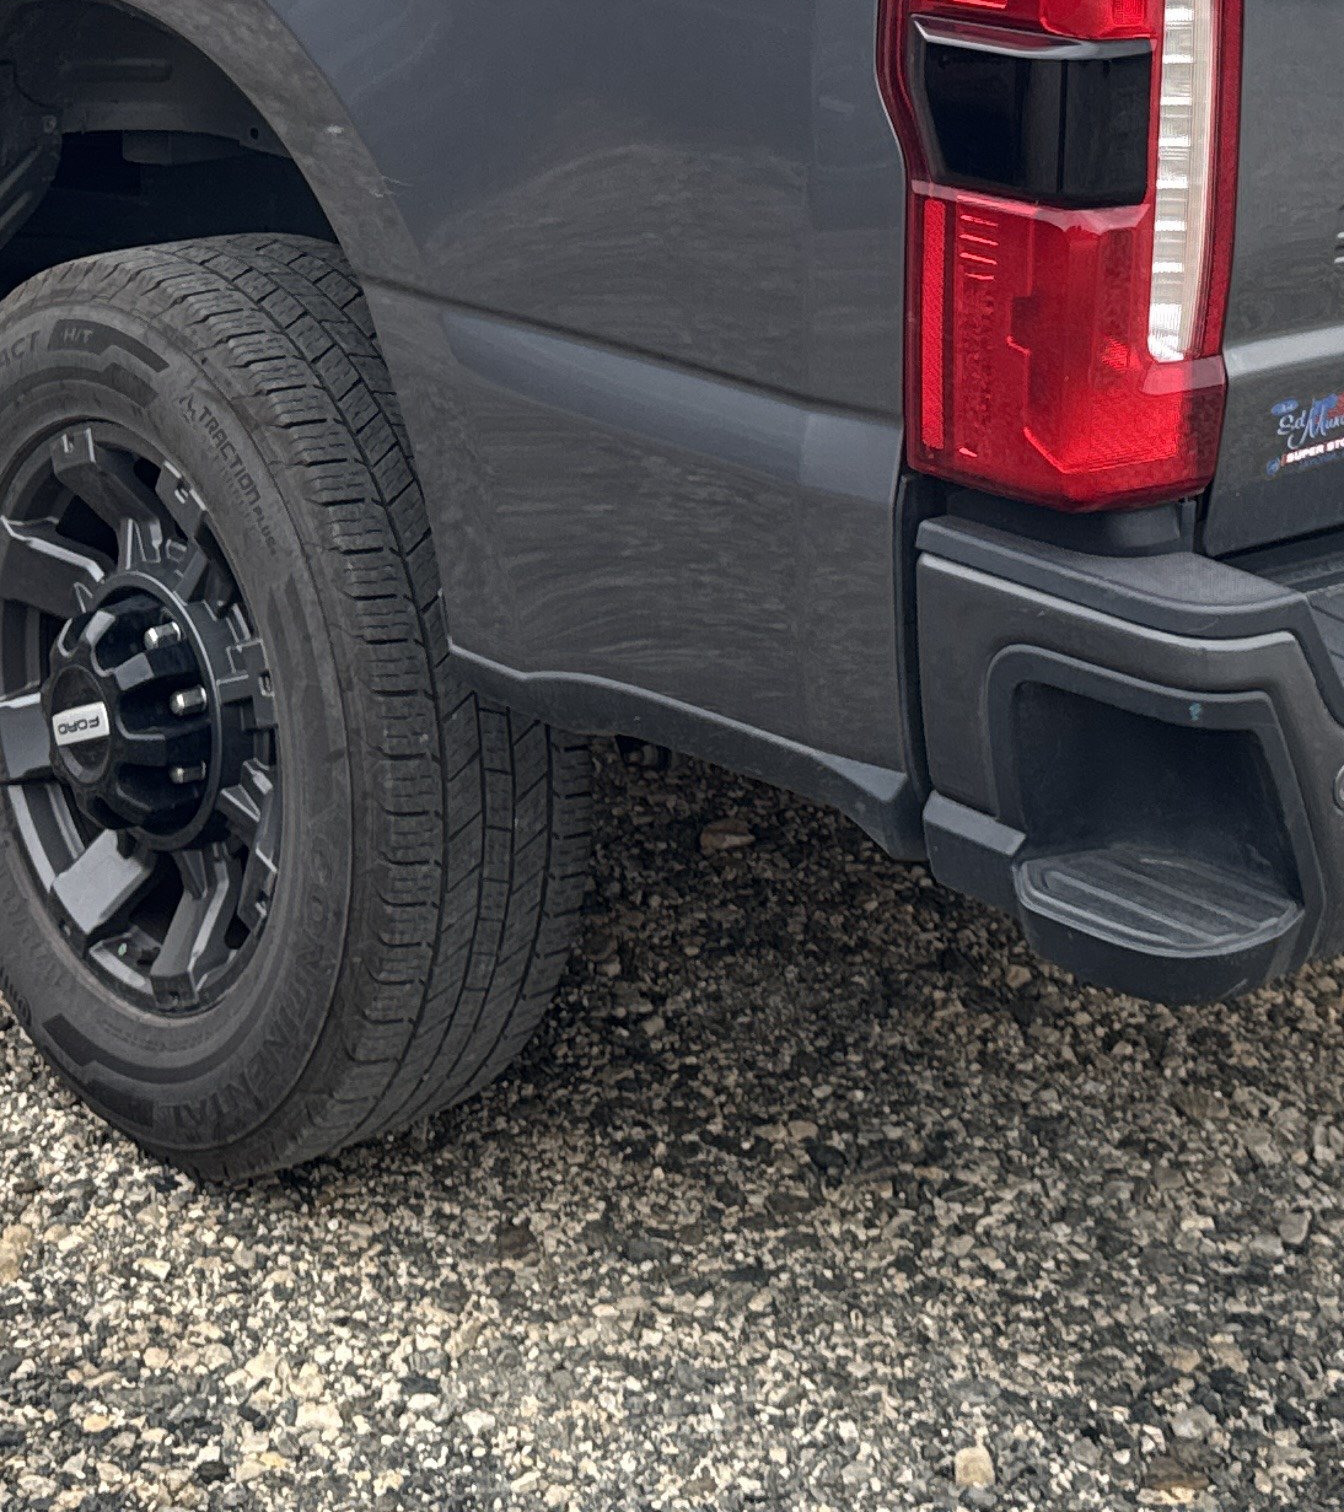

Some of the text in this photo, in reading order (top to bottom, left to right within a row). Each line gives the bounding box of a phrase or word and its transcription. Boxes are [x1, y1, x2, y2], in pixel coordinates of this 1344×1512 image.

[63, 328, 94, 344] H/T
[199, 405, 261, 506] TRACTION
[1285, 444, 1325, 464] SUPER
[58, 715, 101, 736] FORD
